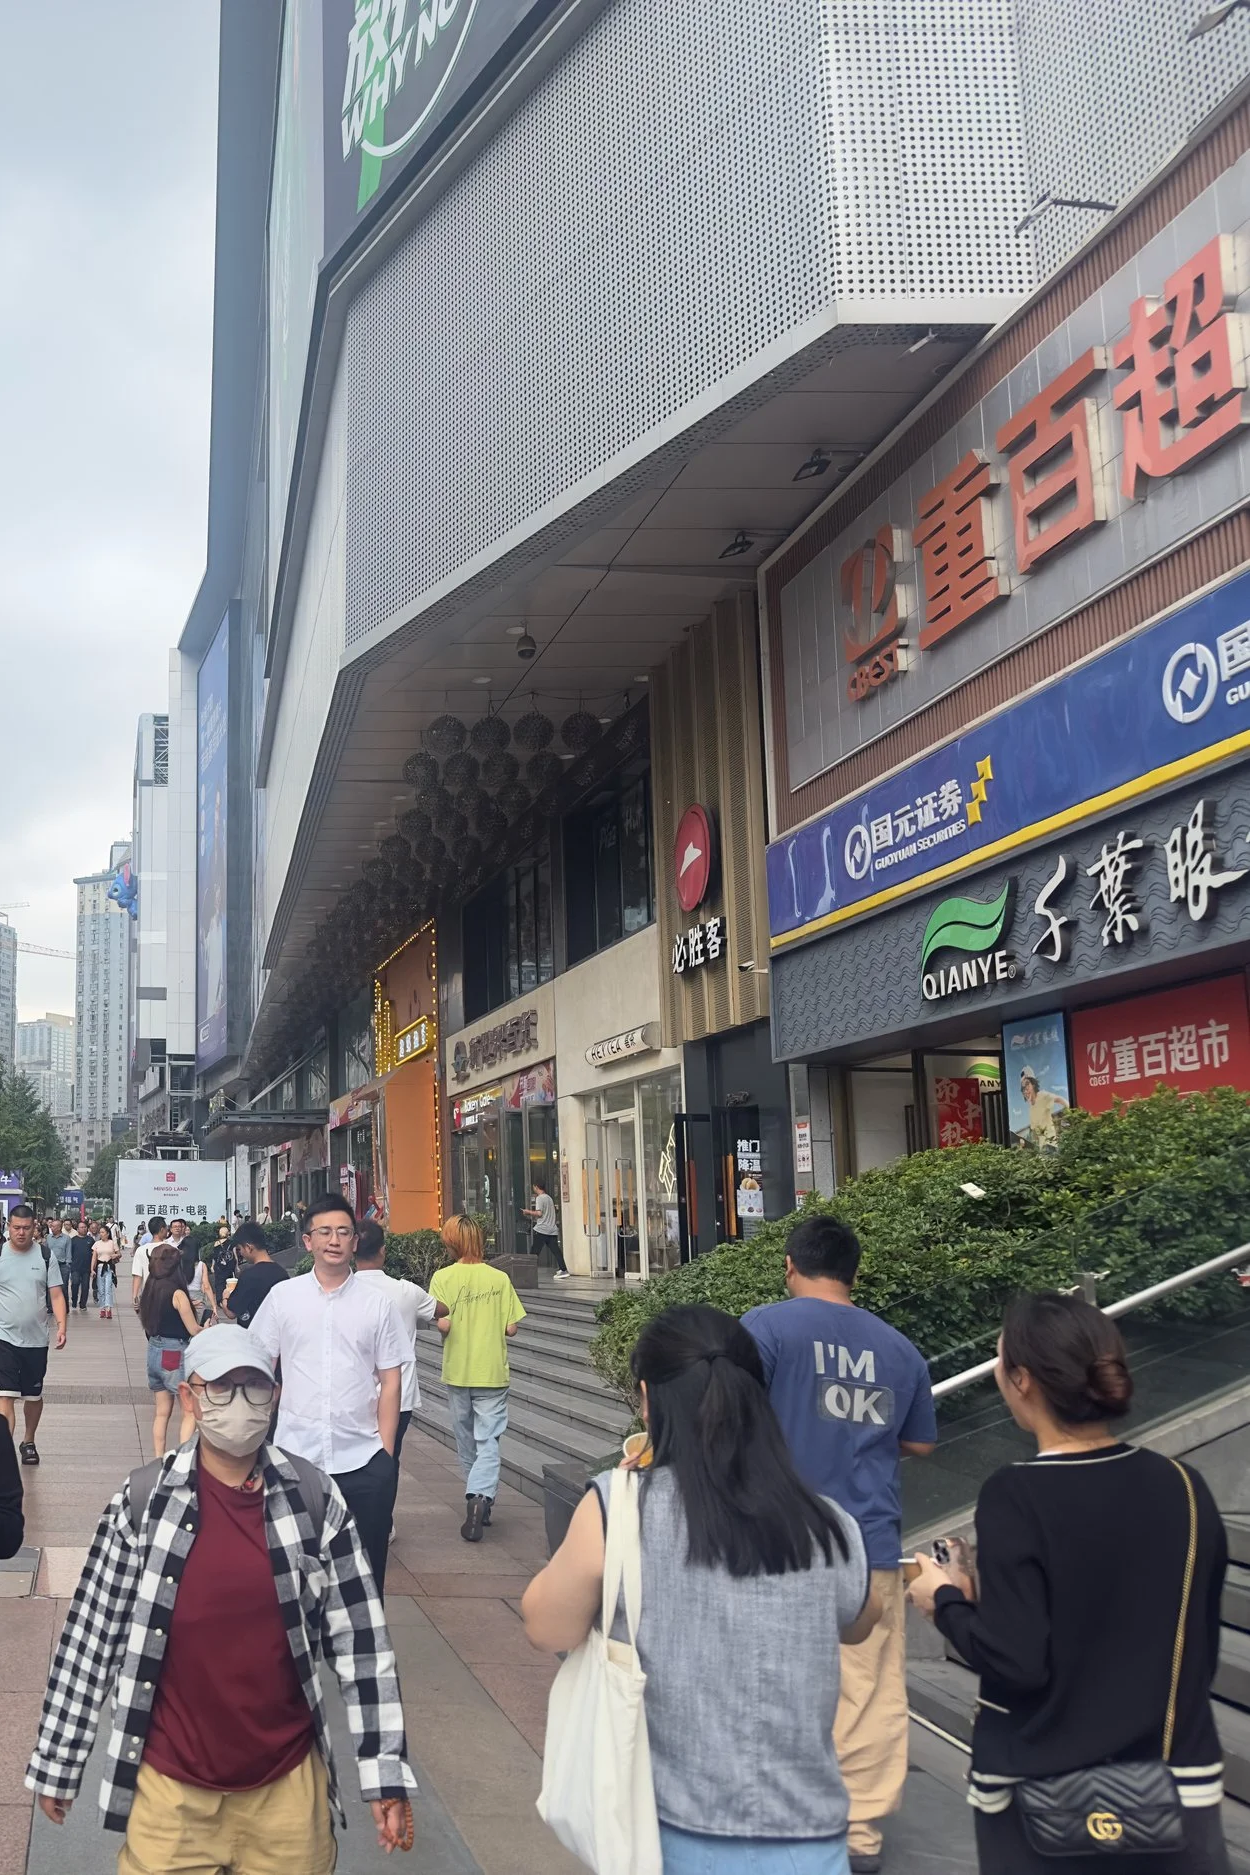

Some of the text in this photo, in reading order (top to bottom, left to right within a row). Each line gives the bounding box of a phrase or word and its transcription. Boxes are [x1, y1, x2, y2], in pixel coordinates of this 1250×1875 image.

[846, 641, 904, 703] CBEST
[870, 779, 963, 853] 国元证券
[874, 819, 966, 871] GUOYUAN SECURITIES
[1032, 799, 1250, 962] 千葉眼
[671, 917, 722, 973] 必胜客
[1111, 1018, 1230, 1083] 重百超市
[979, 1079, 1002, 1088] ANY
[1089, 1074, 1111, 1087] CBEST
[737, 1139, 760, 1152] 推门
[737, 1159, 762, 1172] 降温
[135, 1204, 208, 1216] 重百超市·电器
[813, 1341, 876, 1383] I'M
[823, 1384, 887, 1426] OK
